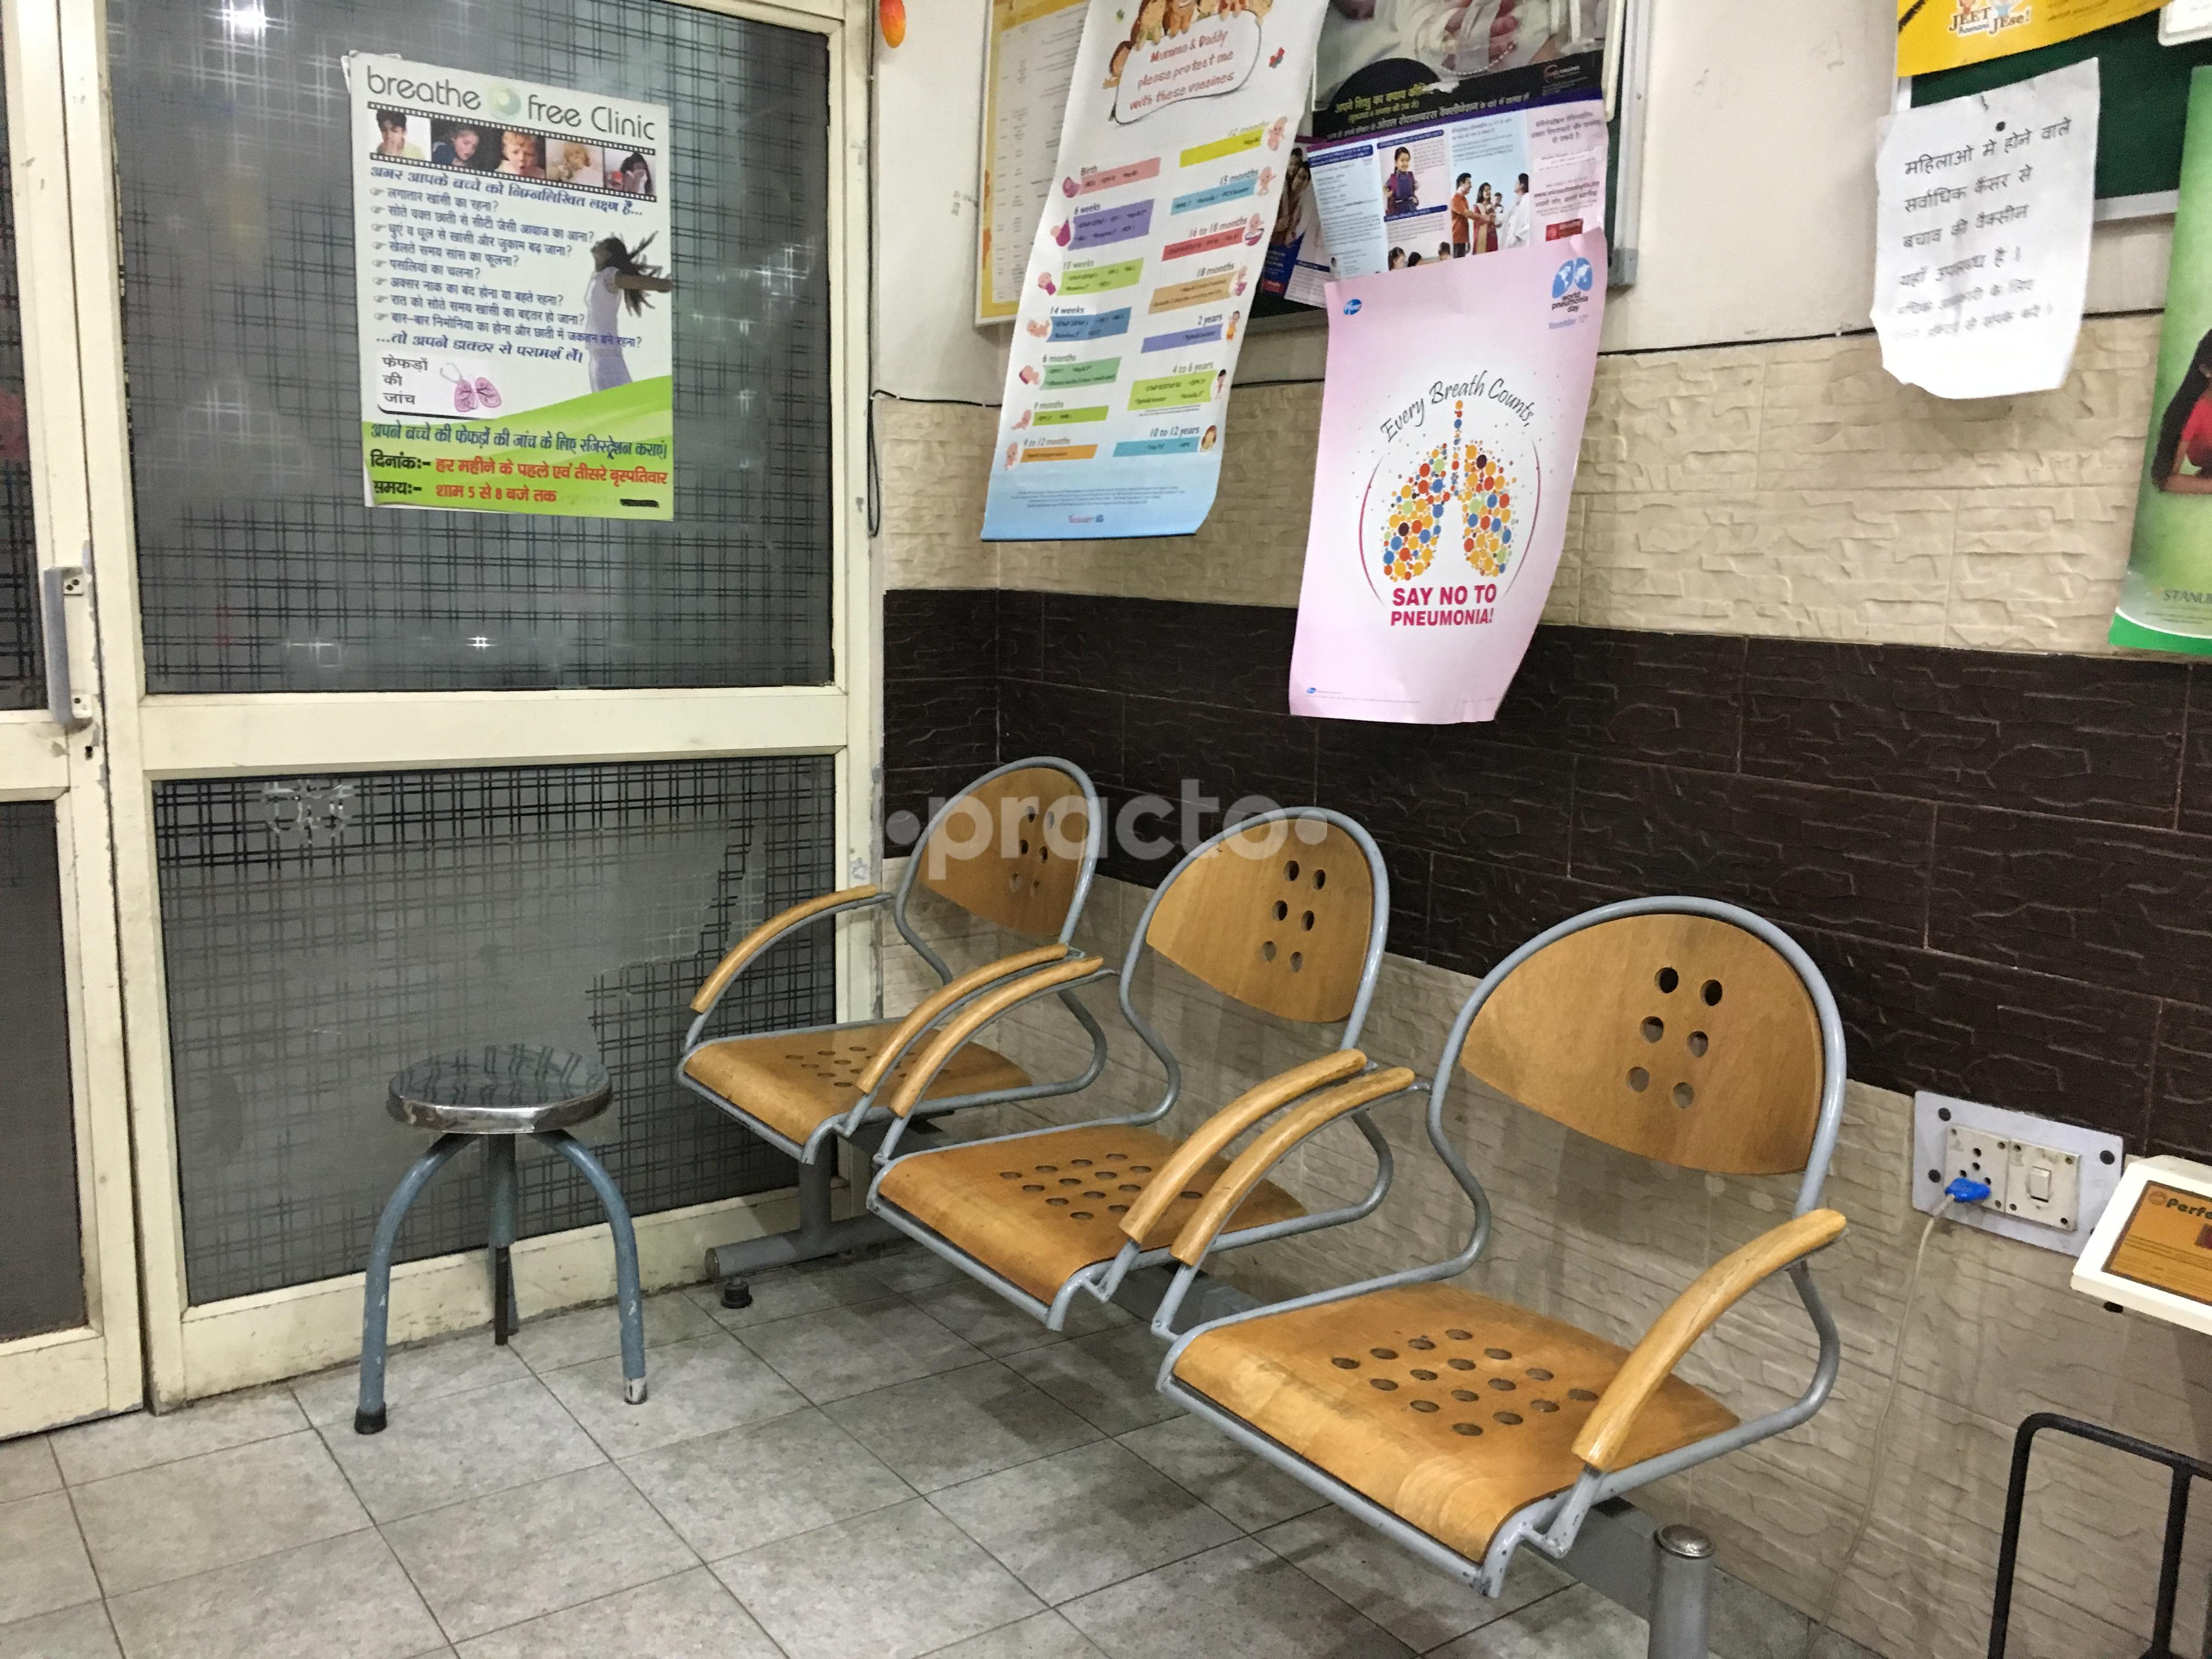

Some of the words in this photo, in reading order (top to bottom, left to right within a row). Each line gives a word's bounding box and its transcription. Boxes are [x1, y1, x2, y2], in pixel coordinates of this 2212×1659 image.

[1189, 38, 1197, 50] &
[1199, 29, 1228, 48] Daddy
[1137, 70, 1171, 92] please
[1217, 50, 1234, 63] me
[1130, 94, 1153, 110] with
[1156, 87, 1186, 103] these
[1188, 72, 1234, 93] vaccines
[366, 65, 481, 110] breathe
[527, 94, 582, 127] free
[591, 105, 655, 141] Clinic
[2004, 128, 2032, 154] होने
[2041, 117, 2072, 139] वाले
[408, 172, 448, 186] आपके
[453, 177, 481, 191] बच्चे
[485, 180, 504, 195] को
[508, 183, 585, 207] निम्नलिखित
[589, 199, 618, 212] लक्षण
[1905, 187, 1967, 213] सर्वाधिक
[2018, 163, 2033, 183] से
[387, 188, 423, 202] लगातार
[454, 197, 467, 208] का
[470, 200, 499, 212] रहना?
[1080, 202, 1101, 213] weeks
[387, 203, 408, 217] सोते
[411, 209, 431, 221] वक्त
[435, 210, 456, 224] छाती
[459, 212, 468, 226] से
[472, 214, 493, 229] सीटी
[496, 217, 517, 233] जैसी
[521, 224, 549, 237] आवाज
[552, 228, 564, 239] का
[1189, 228, 1197, 237] 16
[1210, 223, 1218, 233] 18
[1219, 217, 1248, 229] months
[437, 227, 446, 240] से
[477, 233, 495, 247] और
[498, 237, 526, 252] जुकाम
[544, 244, 572, 257] जाना?
[1903, 228, 1943, 248] बचाव
[419, 245, 442, 257] समय
[470, 252, 482, 262] का
[1073, 259, 1094, 268] weeks
[430, 264, 443, 275] का
[447, 266, 481, 279] चलना?
[1197, 267, 1206, 278] 18
[1207, 262, 1234, 274] months
[391, 277, 420, 290] अक्सर
[422, 280, 443, 292] नाक
[445, 284, 459, 294] का
[479, 284, 498, 299] होना
[501, 290, 511, 300] या
[514, 290, 533, 303] बहते
[537, 294, 563, 306] रहना?
[390, 295, 407, 306] रात
[410, 294, 423, 308] को
[426, 296, 445, 310] सोते
[449, 301, 472, 313] समय
[503, 307, 515, 318] का
[545, 309, 554, 323] हो
[557, 313, 585, 325] जाना?
[1060, 306, 1085, 314] weeks
[1551, 296, 1588, 311] pneumonia
[432, 313, 474, 330] निमोनिया
[477, 321, 489, 332] का
[493, 320, 511, 334] होना
[514, 323, 531, 336] और
[534, 325, 554, 339] छाती
[600, 332, 613, 345] बने
[1198, 315, 1203, 325] 2
[1204, 314, 1222, 327] years
[413, 334, 449, 348] अपने
[499, 341, 512, 355] से
[516, 346, 564, 360] परामर्श
[382, 354, 428, 373] फेफड़ों
[1048, 353, 1076, 362] months
[1172, 365, 1177, 374] 4
[1179, 363, 1187, 373] to
[1187, 362, 1193, 371] 6
[1194, 362, 1214, 374] years
[382, 371, 403, 386] की
[382, 390, 416, 404] जांच
[1039, 400, 1064, 409] months
[1380, 398, 1425, 443] Every
[1429, 370, 1488, 405] Breath
[1487, 377, 1535, 427] Counts,
[371, 420, 401, 439] अपने
[405, 422, 431, 441] बच्चे
[435, 423, 452, 443] की
[455, 425, 490, 449] फेफड़ों
[494, 428, 510, 447] की
[514, 430, 538, 449] जांच
[540, 430, 552, 449] के
[556, 431, 577, 454] लिए
[580, 433, 633, 460] रजिस्ट्रेशन
[1046, 436, 1071, 445] months
[1150, 428, 1158, 437] 10
[1159, 428, 1168, 436] to
[1170, 426, 1179, 436] 12
[1180, 426, 1200, 437] years
[436, 458, 455, 473] हर
[458, 456, 495, 475] महीने
[499, 458, 514, 475] के
[517, 461, 549, 478] पहले
[552, 462, 573, 479] एवं
[574, 462, 607, 481] तीसरे
[610, 466, 668, 487] बृस्पतिवार
[436, 484, 465, 498] शाम
[469, 486, 475, 498] 5
[479, 482, 492, 499] से
[495, 488, 502, 500] 8
[506, 484, 529, 501] बजे
[533, 489, 557, 503] तक
[1392, 587, 1434, 607] SAY
[1439, 585, 1468, 605] NO
[1474, 583, 1497, 604] TO
[1390, 608, 1494, 627] PNEUMONIA!
